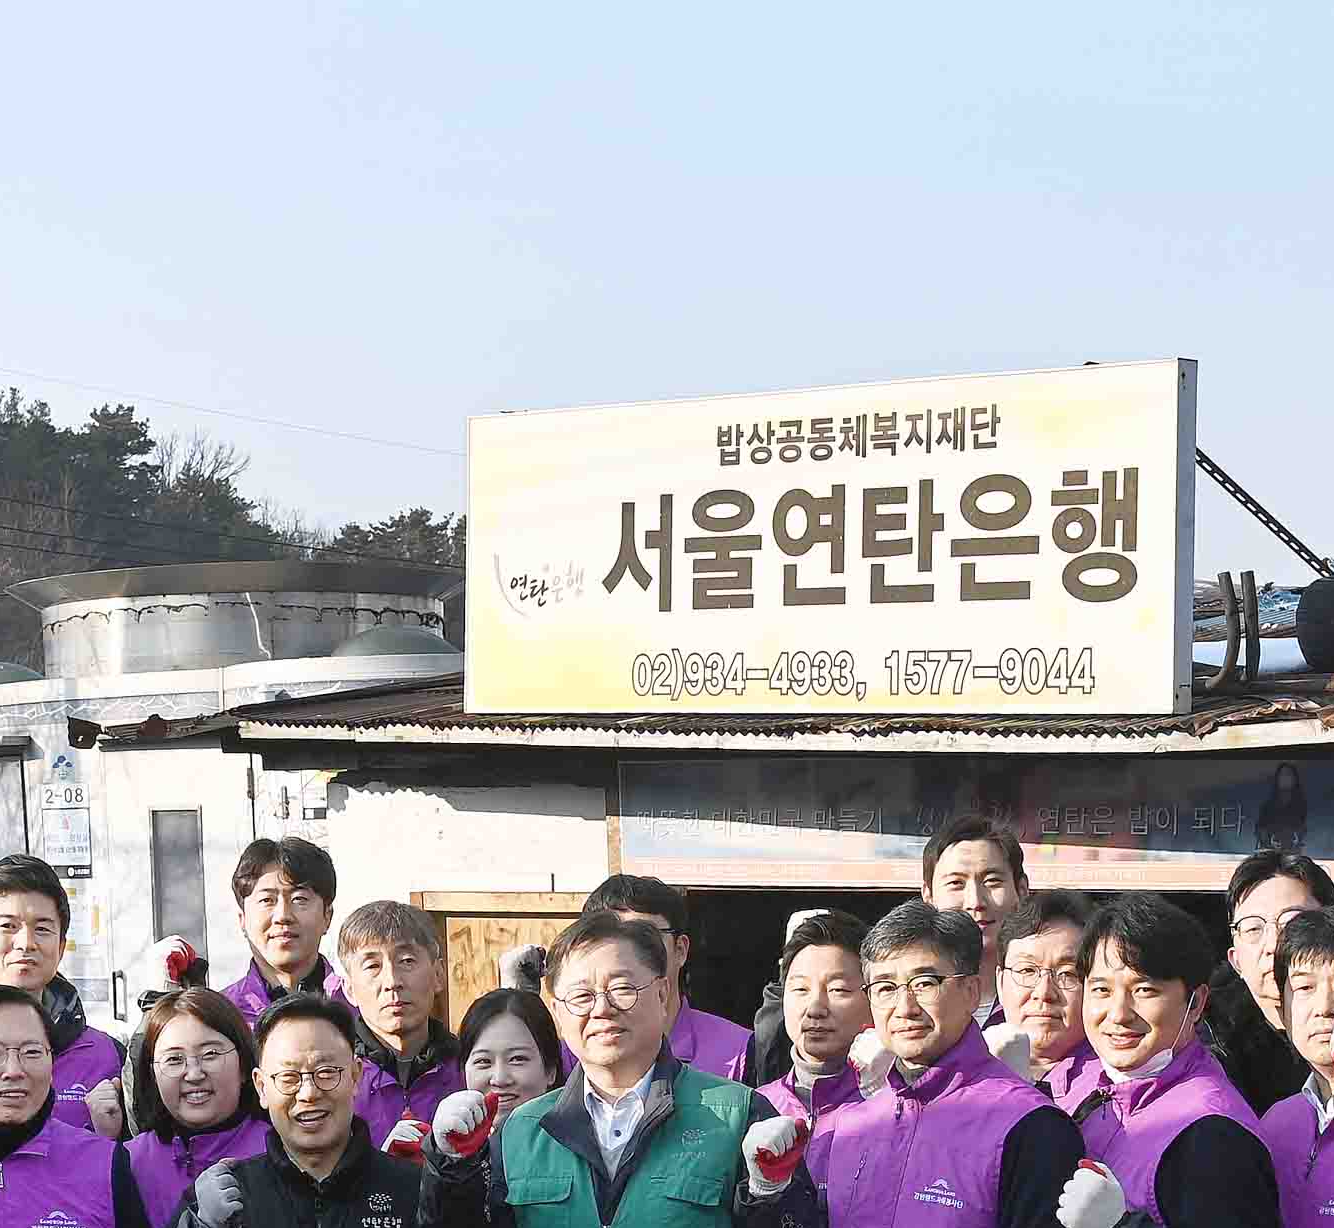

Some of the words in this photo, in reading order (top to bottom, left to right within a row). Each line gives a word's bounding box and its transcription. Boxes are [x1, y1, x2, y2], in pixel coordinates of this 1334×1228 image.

[717, 404, 1000, 465] 밥상공동체복지재단
[602, 467, 1139, 612] 서울연탄은행
[632, 648, 866, 702] 02)934-4933,
[885, 647, 1095, 696] 1577-9044
[44, 787, 84, 804] 2-08
[812, 807, 884, 838] 만들기
[1036, 803, 1118, 835] 연탄은
[1129, 803, 1179, 836] 밥이
[1191, 803, 1248, 836] 되다
